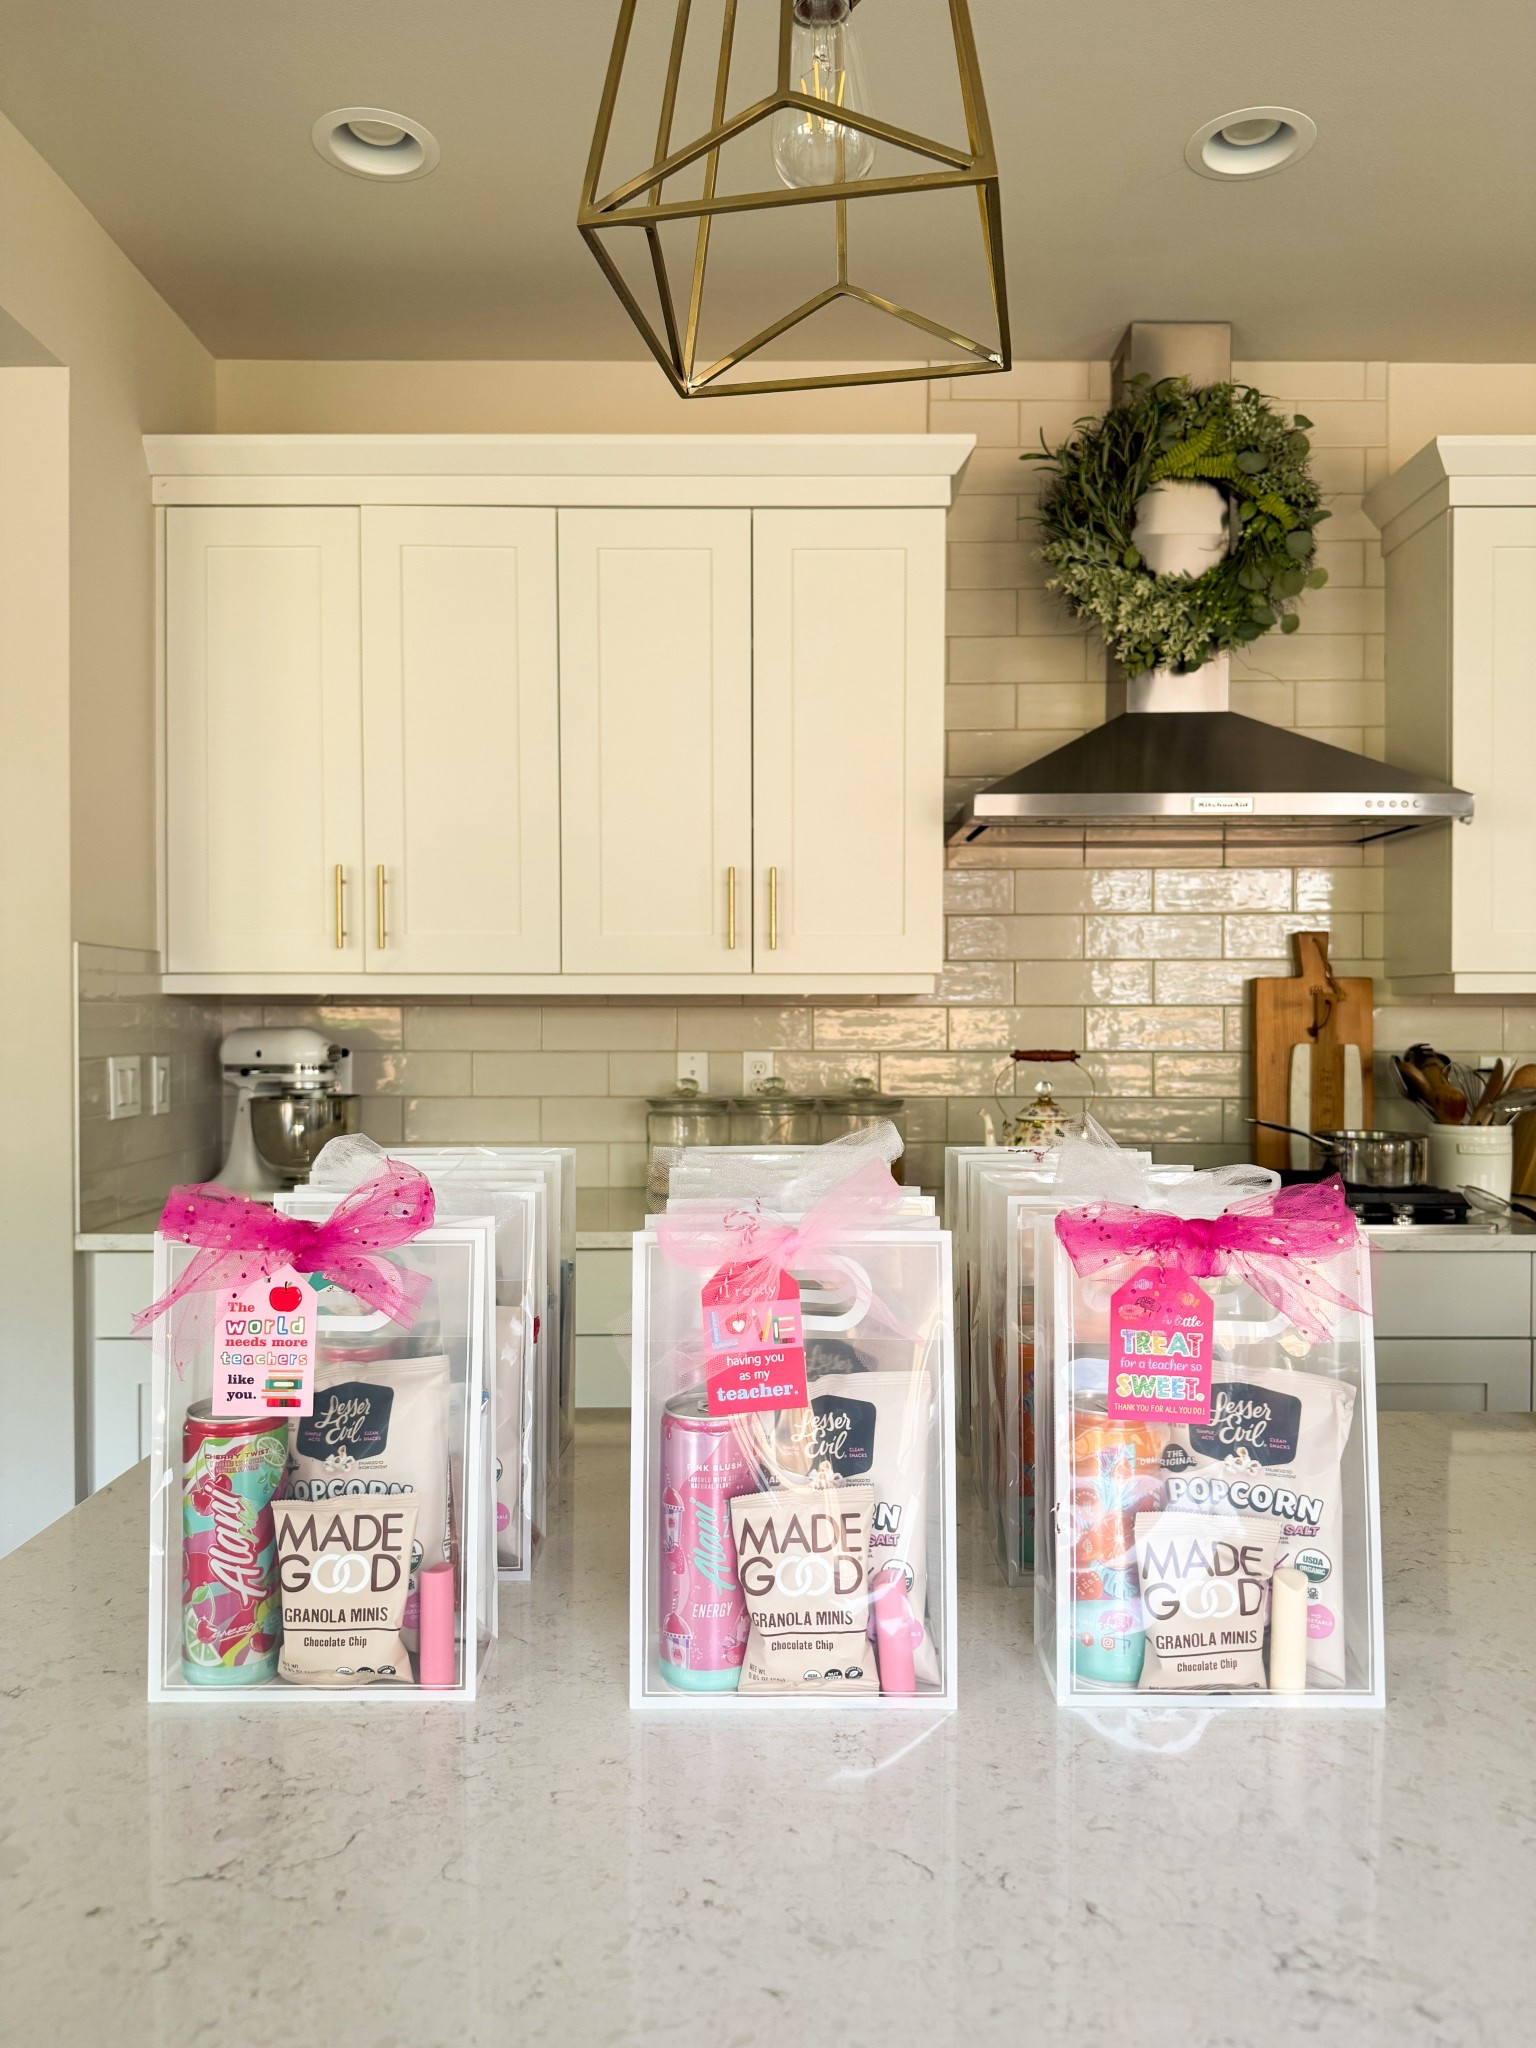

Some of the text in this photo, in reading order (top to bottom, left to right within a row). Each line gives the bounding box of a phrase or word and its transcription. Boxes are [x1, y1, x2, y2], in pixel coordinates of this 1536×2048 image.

[227, 1301, 255, 1312] The
[225, 1316, 305, 1336] world
[709, 1307, 796, 1350] LOVE
[225, 1337, 308, 1347] needs more
[1120, 1329, 1204, 1358] TREAT
[221, 1352, 308, 1366] teachers
[726, 1353, 785, 1367] having you
[1120, 1357, 1137, 1368] for
[1148, 1358, 1188, 1371] teacher
[1190, 1363, 1202, 1372] so
[227, 1374, 255, 1385] like
[739, 1370, 770, 1381] as my
[227, 1391, 257, 1402] you.
[716, 1383, 799, 1402] teacher.
[1116, 1373, 1205, 1401] SWEET.
[314, 1395, 372, 1428] Lesser
[1114, 1402, 1205, 1415] THANK YOU FOR ALL YOU DO!
[1207, 1391, 1272, 1426] Lesser
[325, 1415, 366, 1445] Evil
[791, 1409, 852, 1442] Lesser
[1219, 1413, 1268, 1447] Evil
[804, 1428, 848, 1460] Evil
[1166, 1449, 1184, 1458] THE
[1160, 1456, 1198, 1466] RIGINAL
[1166, 1477, 1323, 1525] POPCORN
[279, 1513, 404, 1551] MADE
[739, 1513, 863, 1555] MADE
[1284, 1524, 1320, 1537] SALT
[204, 1483, 267, 1606] Alani
[690, 1497, 736, 1596] Alani
[1142, 1538, 1264, 1579] MADE
[1302, 1555, 1324, 1566] USDA
[281, 1553, 401, 1594] GOOD
[740, 1555, 864, 1597] GOOD
[1299, 1565, 1326, 1576] ORGANIC
[1144, 1578, 1265, 1620] GOOD
[284, 1608, 347, 1623] GRANOLA
[350, 1606, 389, 1622] MINIS
[692, 1601, 733, 1618] ENERGY
[751, 1609, 854, 1628] GRANOLA MINIS
[303, 1635, 368, 1648] Chocolate Chip
[771, 1639, 834, 1651] Chocolate Chip
[1156, 1630, 1258, 1650] GRANOLA MINIS
[1177, 1658, 1238, 1672] Chocolate Chip
